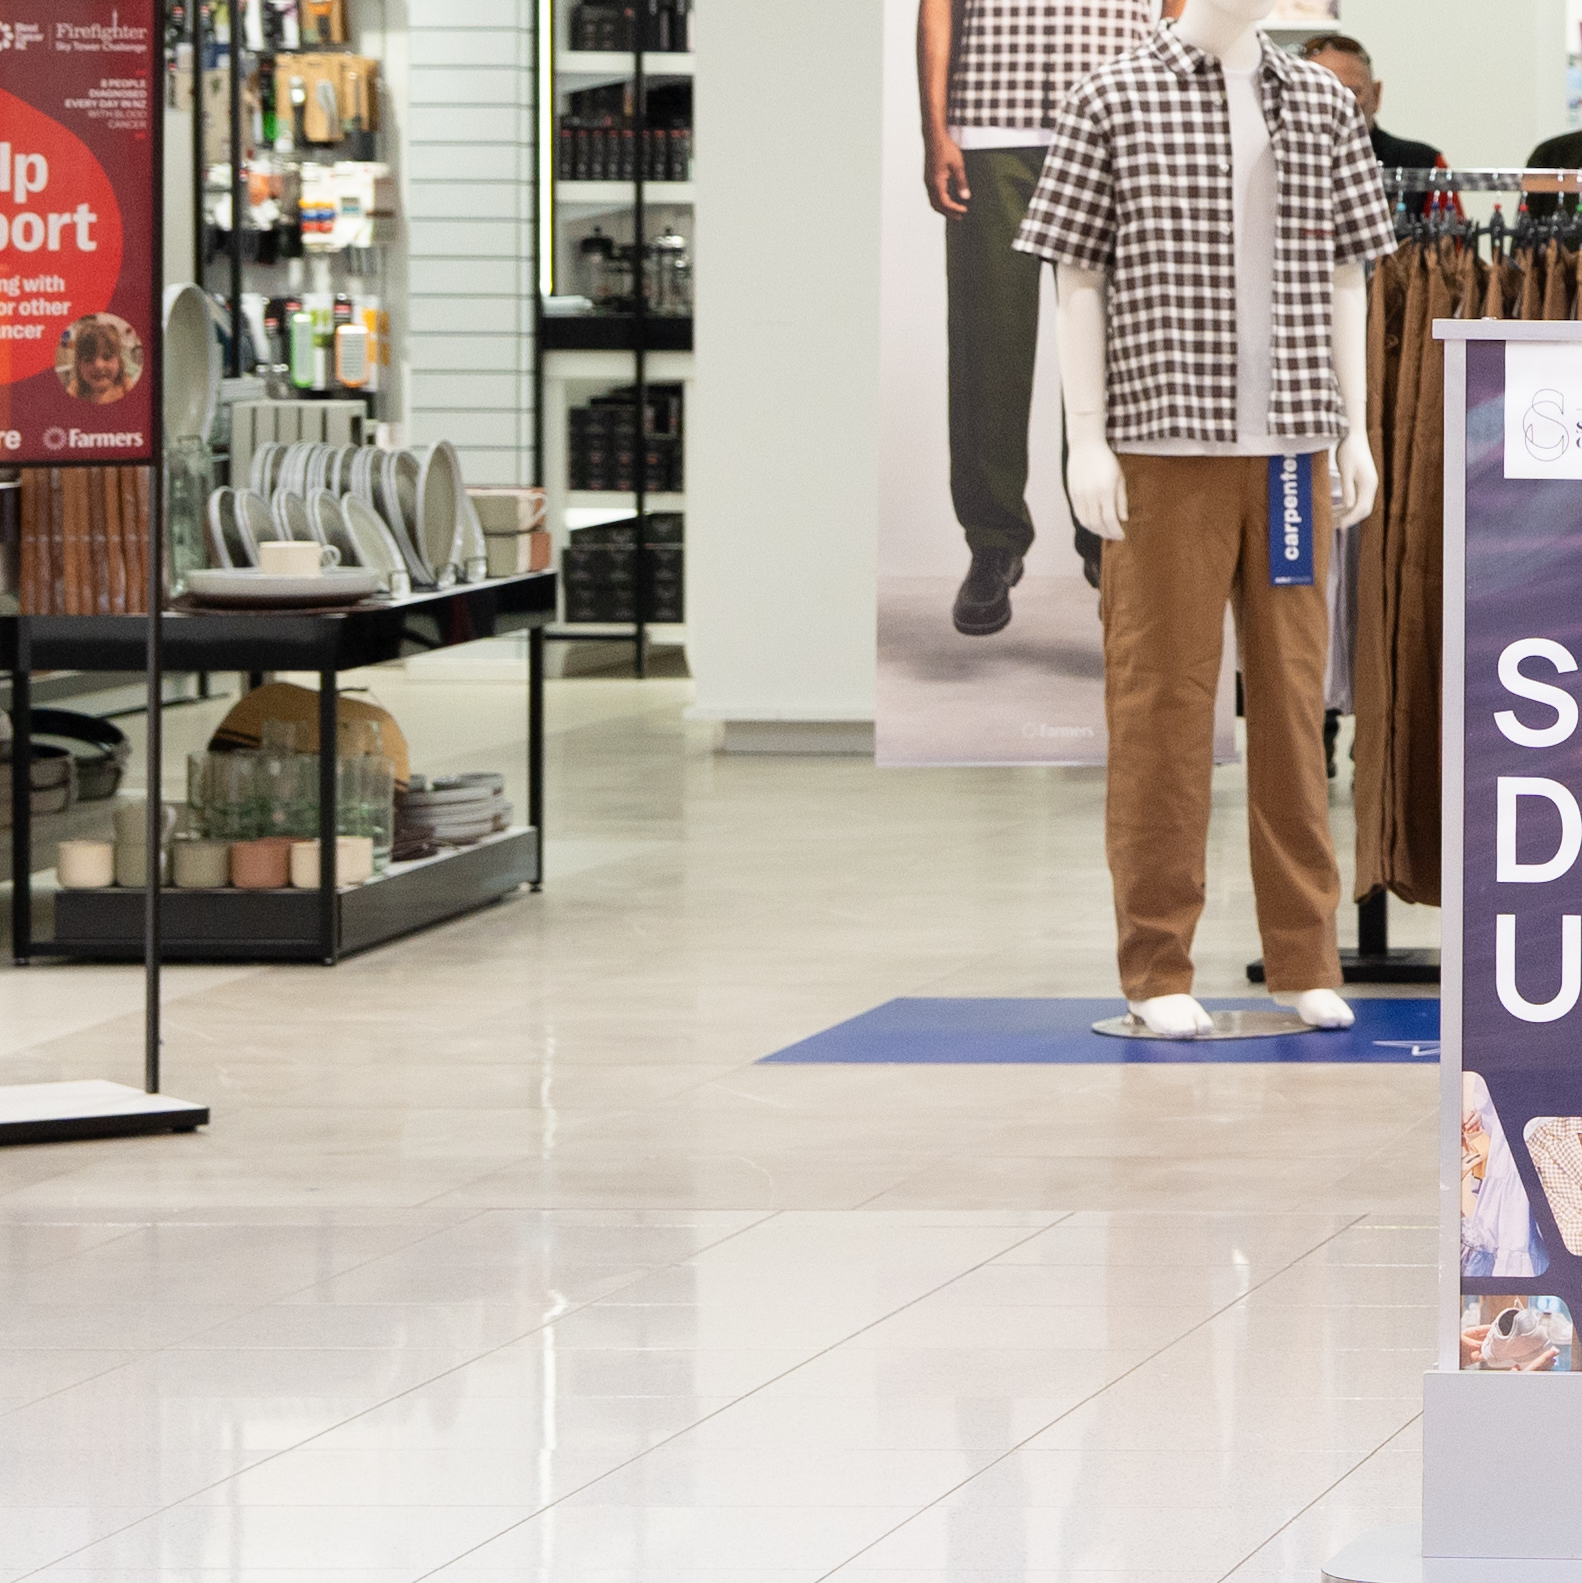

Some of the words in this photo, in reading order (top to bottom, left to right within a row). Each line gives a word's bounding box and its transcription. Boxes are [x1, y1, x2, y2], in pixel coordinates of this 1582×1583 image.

[22, 274, 66, 293] with
[18, 298, 72, 316] other
[68, 427, 144, 449] Farmers
